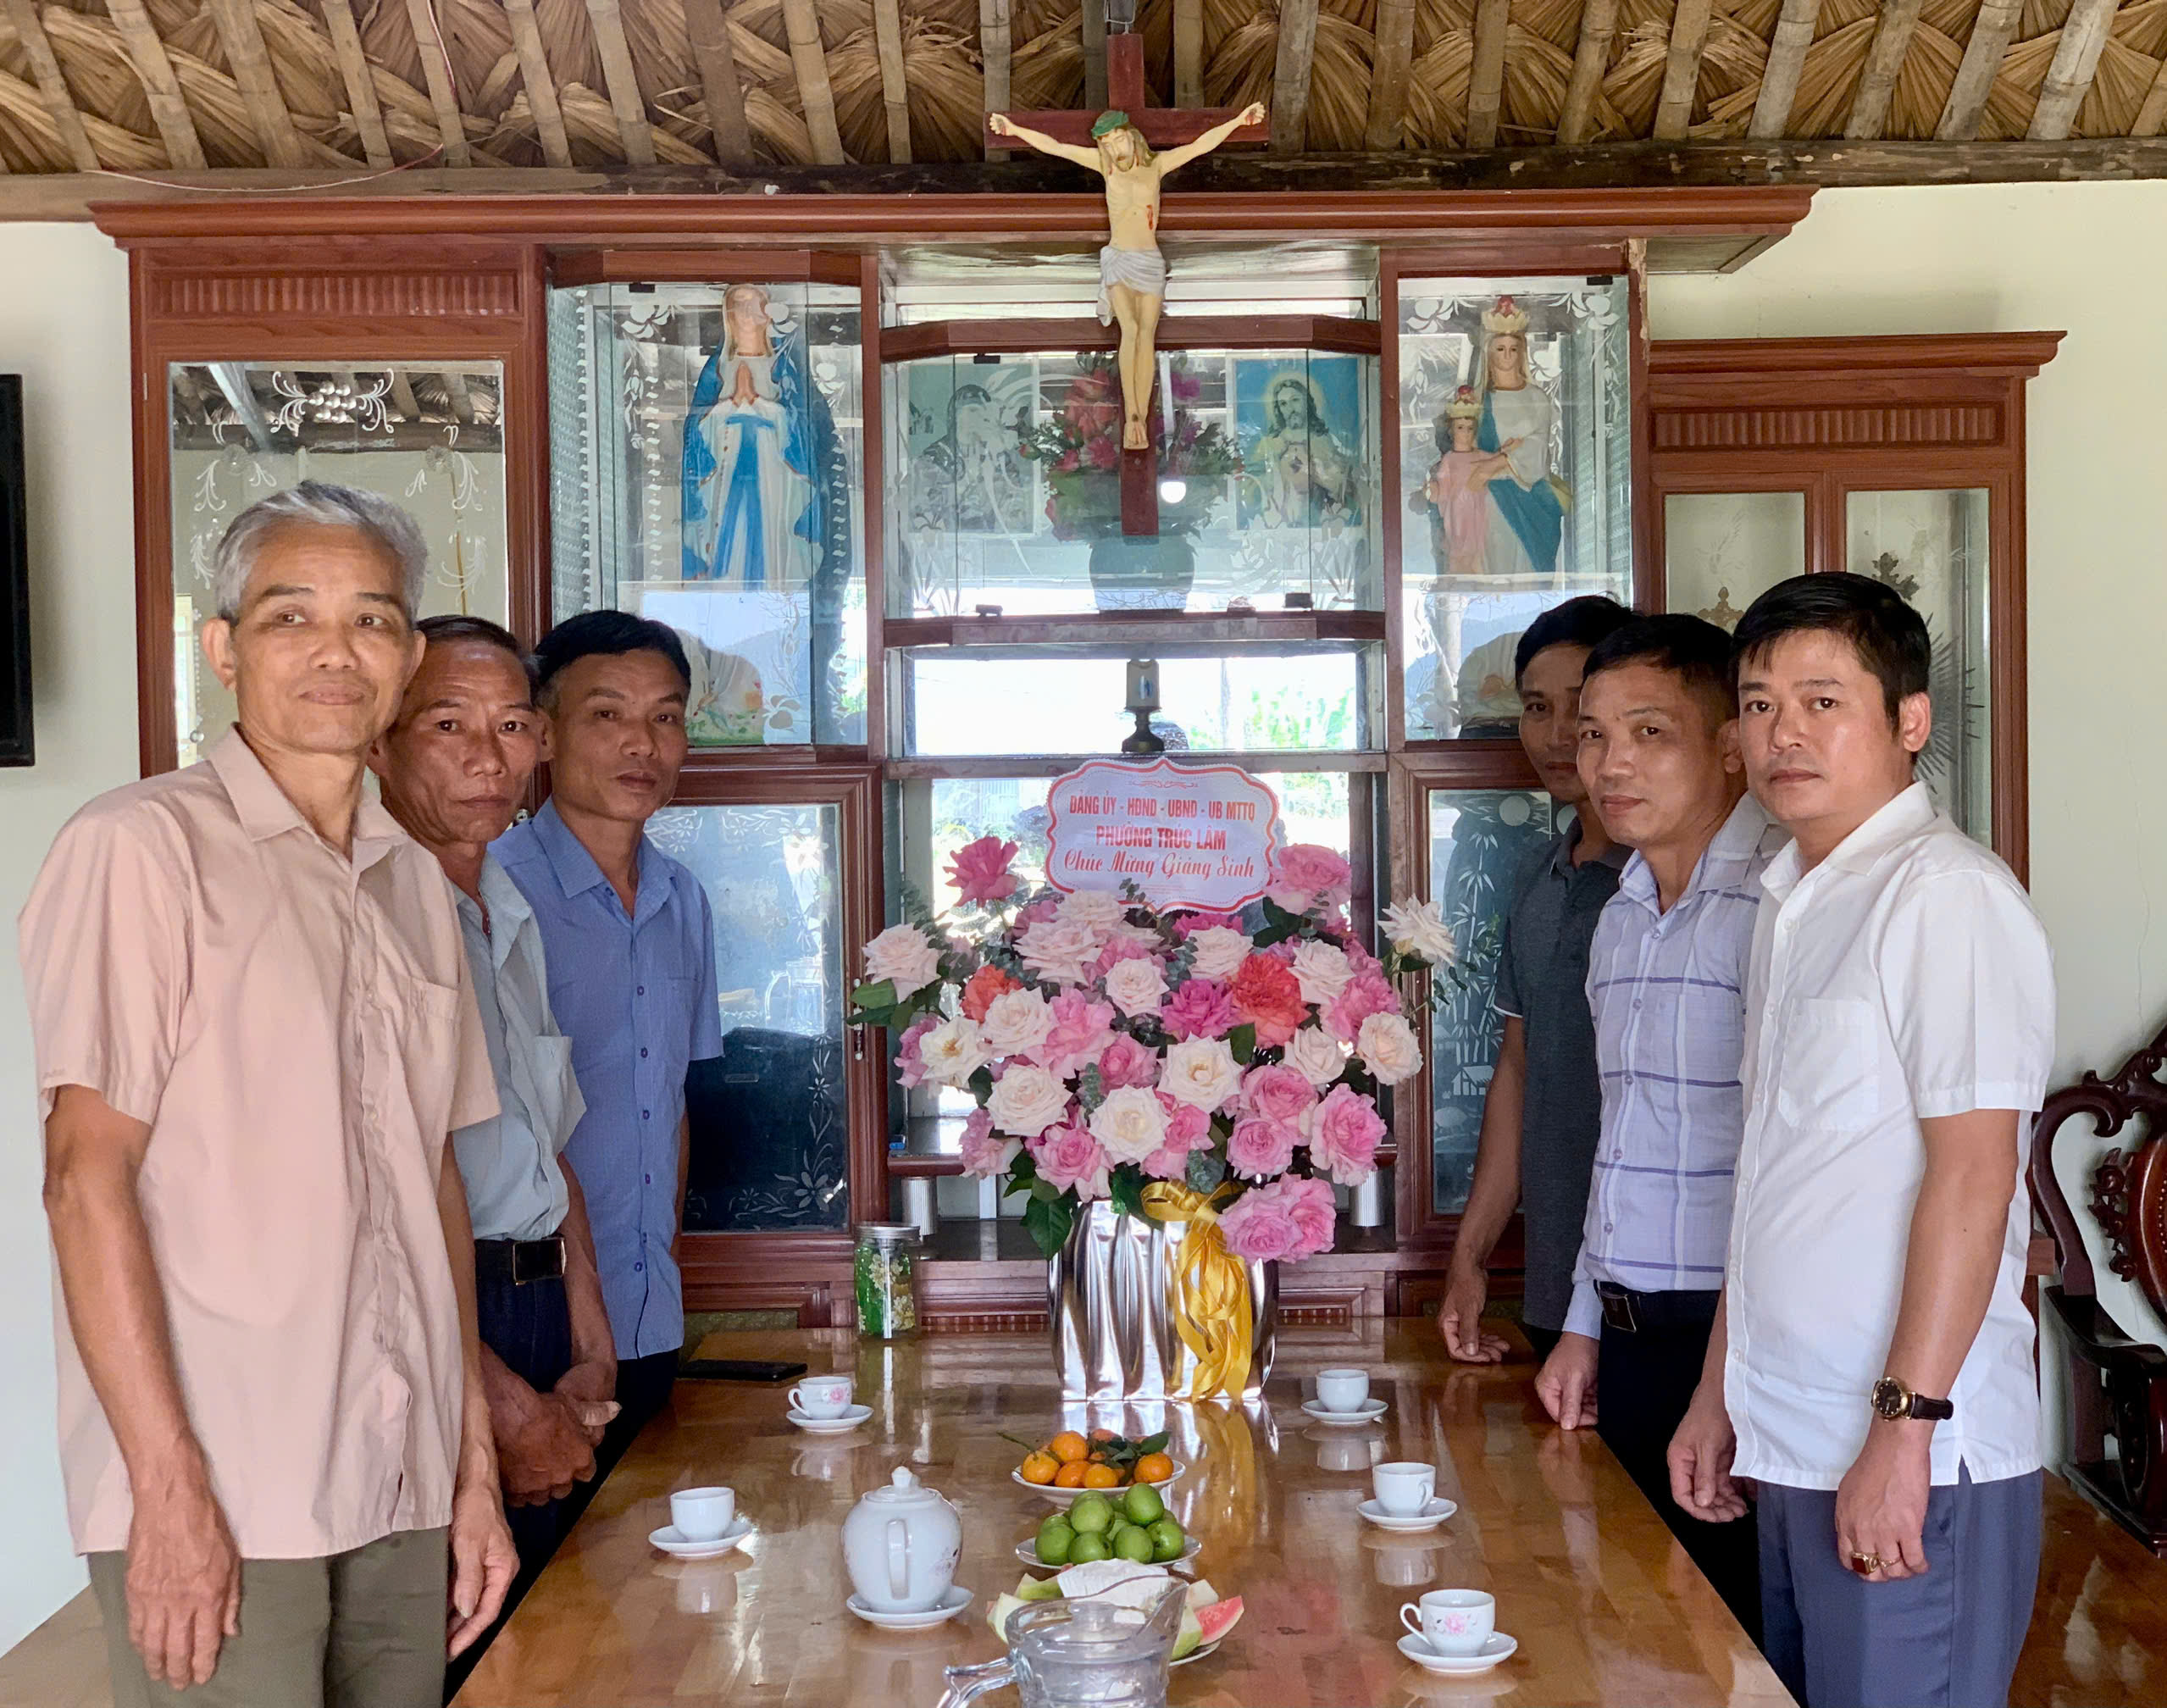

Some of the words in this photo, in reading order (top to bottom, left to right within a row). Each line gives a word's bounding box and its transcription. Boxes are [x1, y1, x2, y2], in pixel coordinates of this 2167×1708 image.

[1069, 790, 1100, 814] ĐẢNG
[1103, 790, 1117, 814] ỦY
[1128, 798, 1157, 817] HĐND
[1168, 800, 1197, 818] UBND
[1208, 801, 1223, 819] UB
[1227, 802, 1255, 822] MTTQ
[1157, 824, 1192, 849] TRÚC
[1196, 825, 1226, 851] LÂM
[1064, 848, 1103, 872] Chúc
[1107, 851, 1156, 877] Mừng
[1161, 852, 1213, 880] Giáng
[1217, 856, 1255, 878] Sinh
